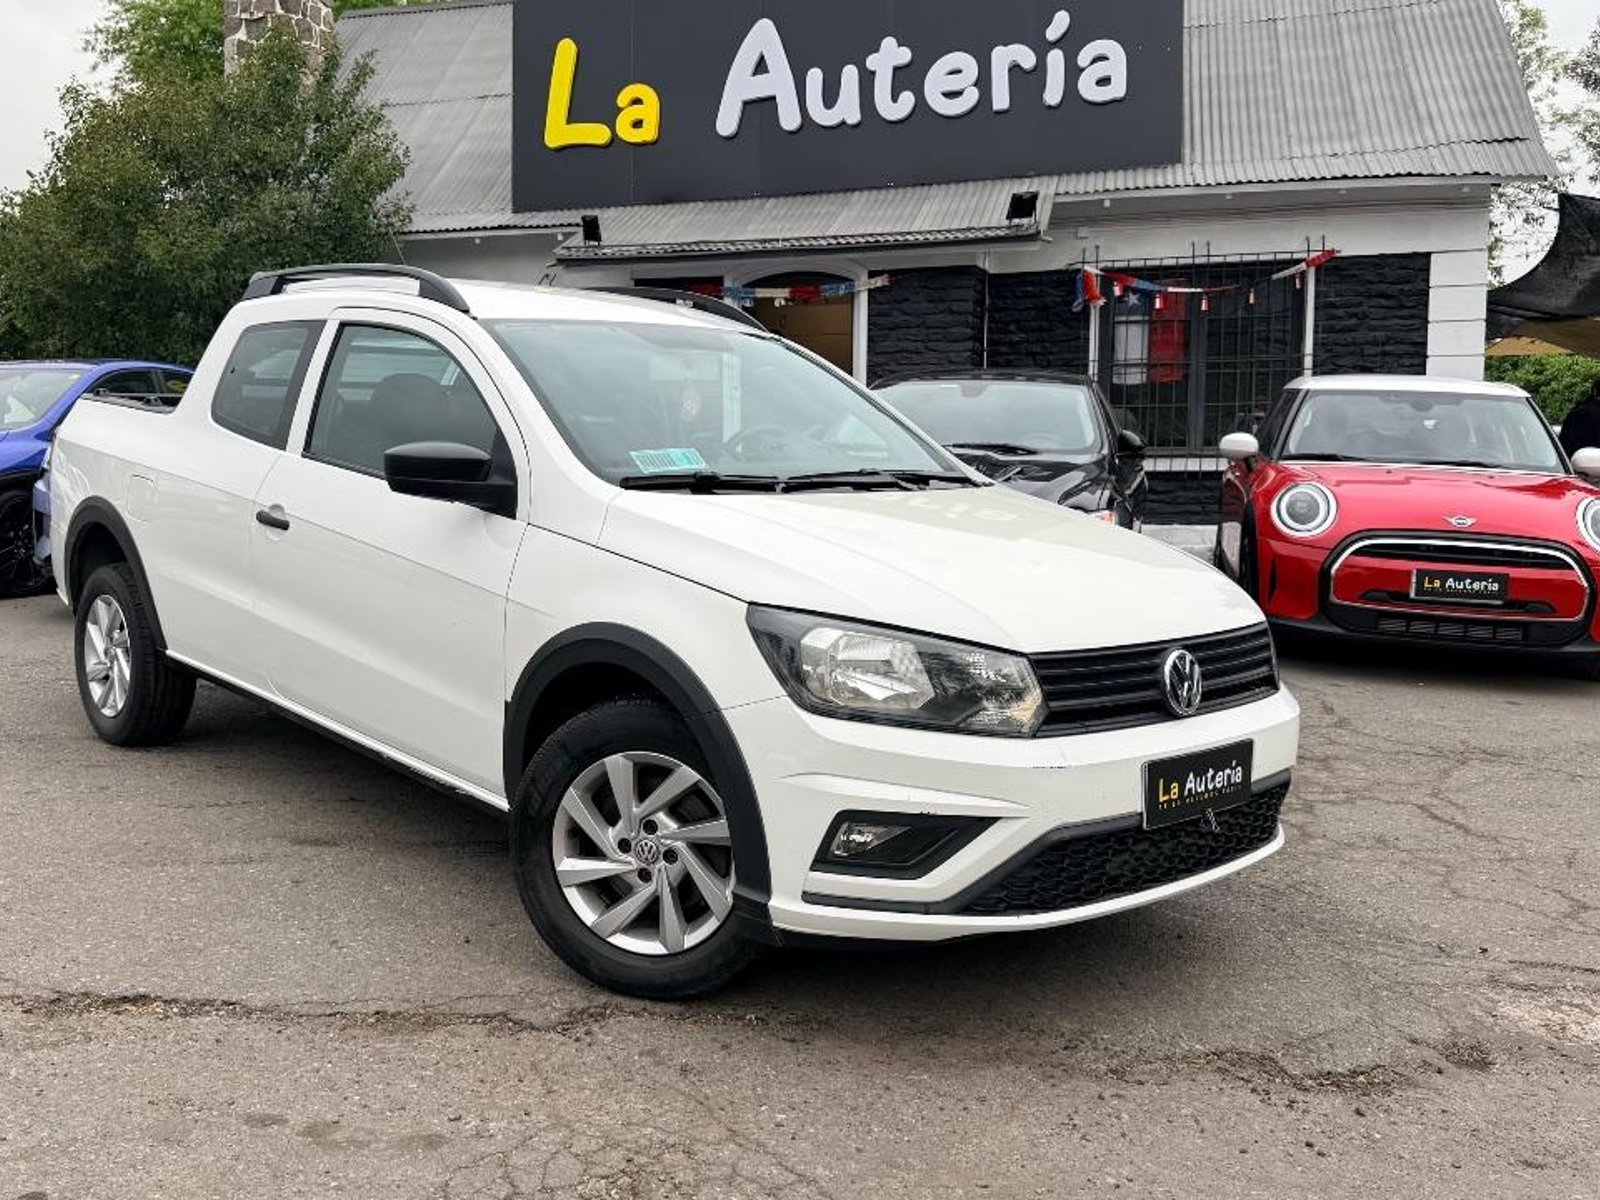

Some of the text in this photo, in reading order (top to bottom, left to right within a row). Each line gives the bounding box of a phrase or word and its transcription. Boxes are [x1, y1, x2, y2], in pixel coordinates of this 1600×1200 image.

[543, 10, 1128, 149] La Autería
[1424, 576, 1440, 588] La
[1159, 778, 1179, 802] La
[1184, 760, 1242, 796] Autería
